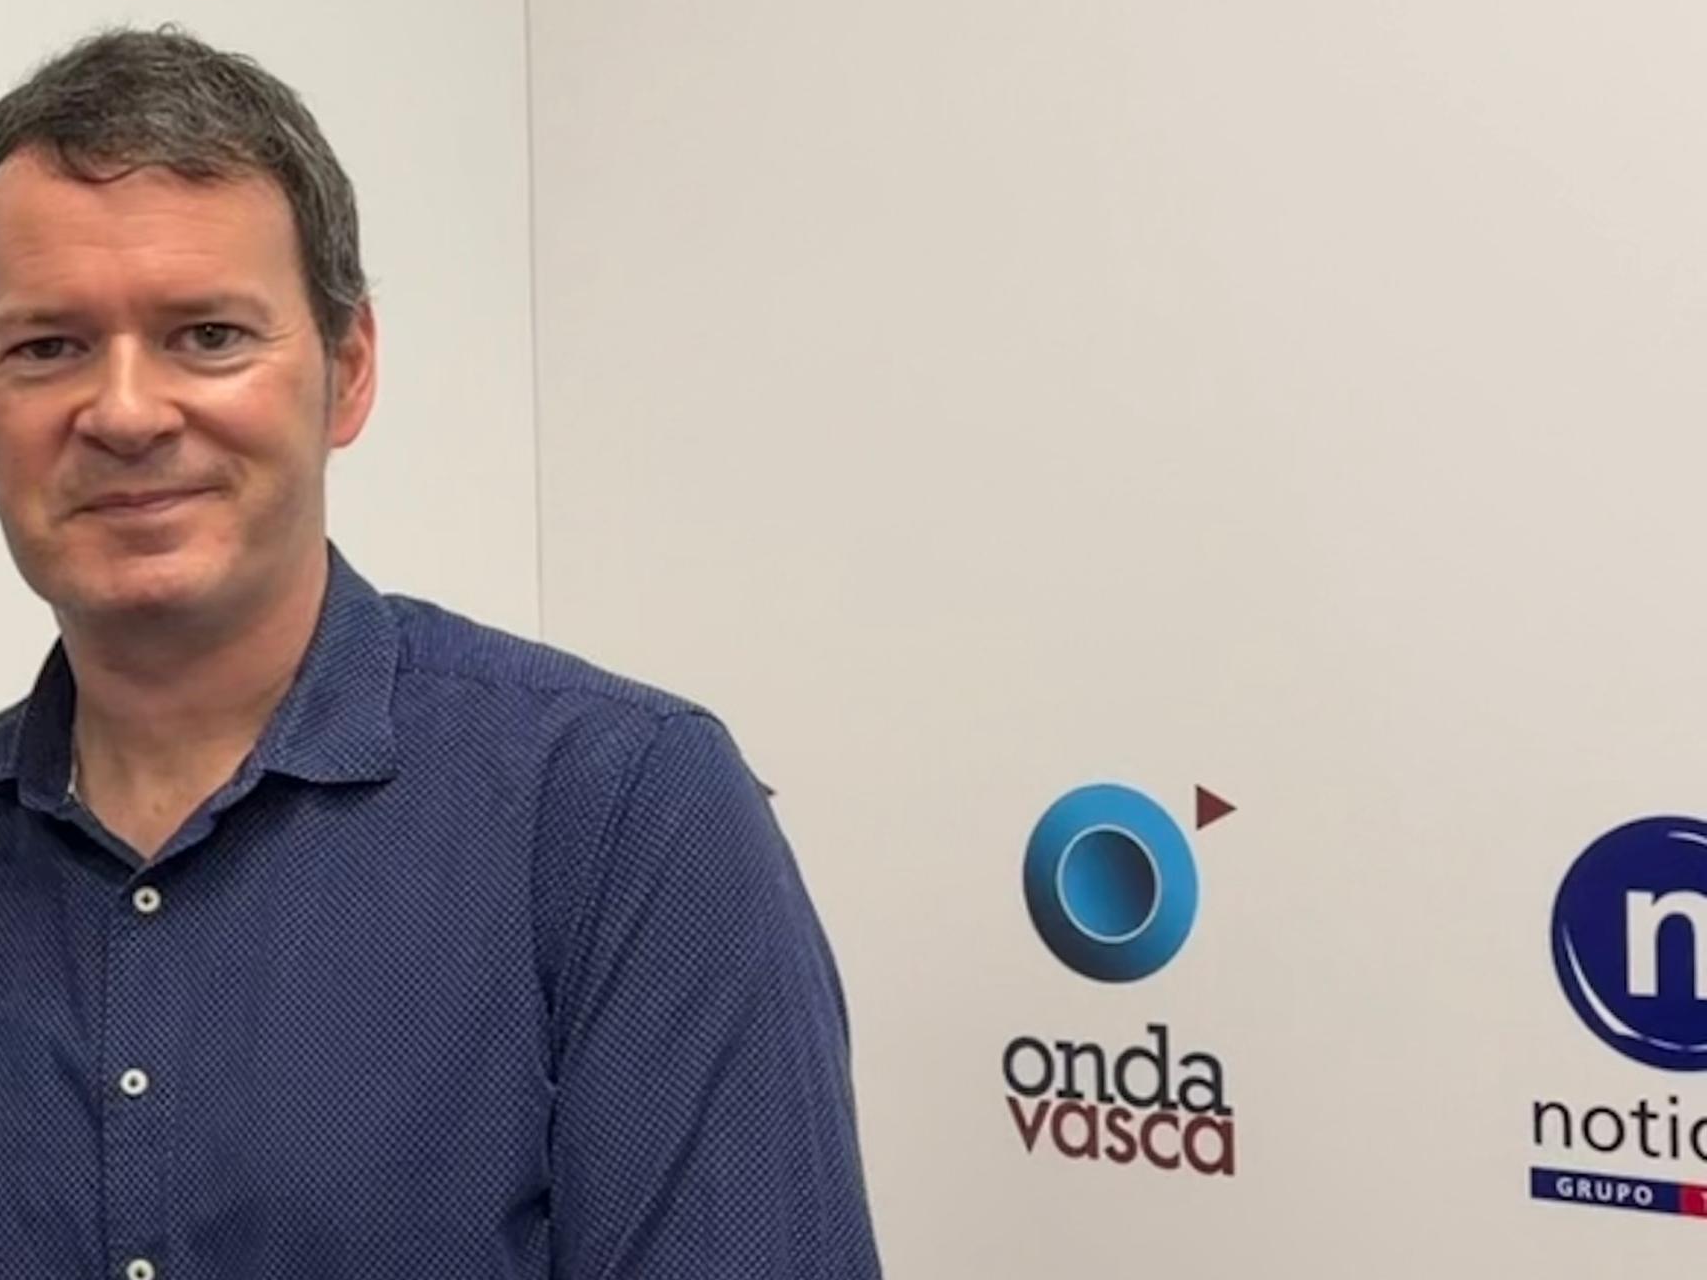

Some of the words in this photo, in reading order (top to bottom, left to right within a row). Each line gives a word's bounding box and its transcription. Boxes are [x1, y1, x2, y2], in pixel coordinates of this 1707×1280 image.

[1626, 889, 1707, 1000] n
[1002, 1024, 1232, 1117] onda
[1006, 1096, 1235, 1176] vasca
[1556, 1176, 1653, 1205] GRUPO
